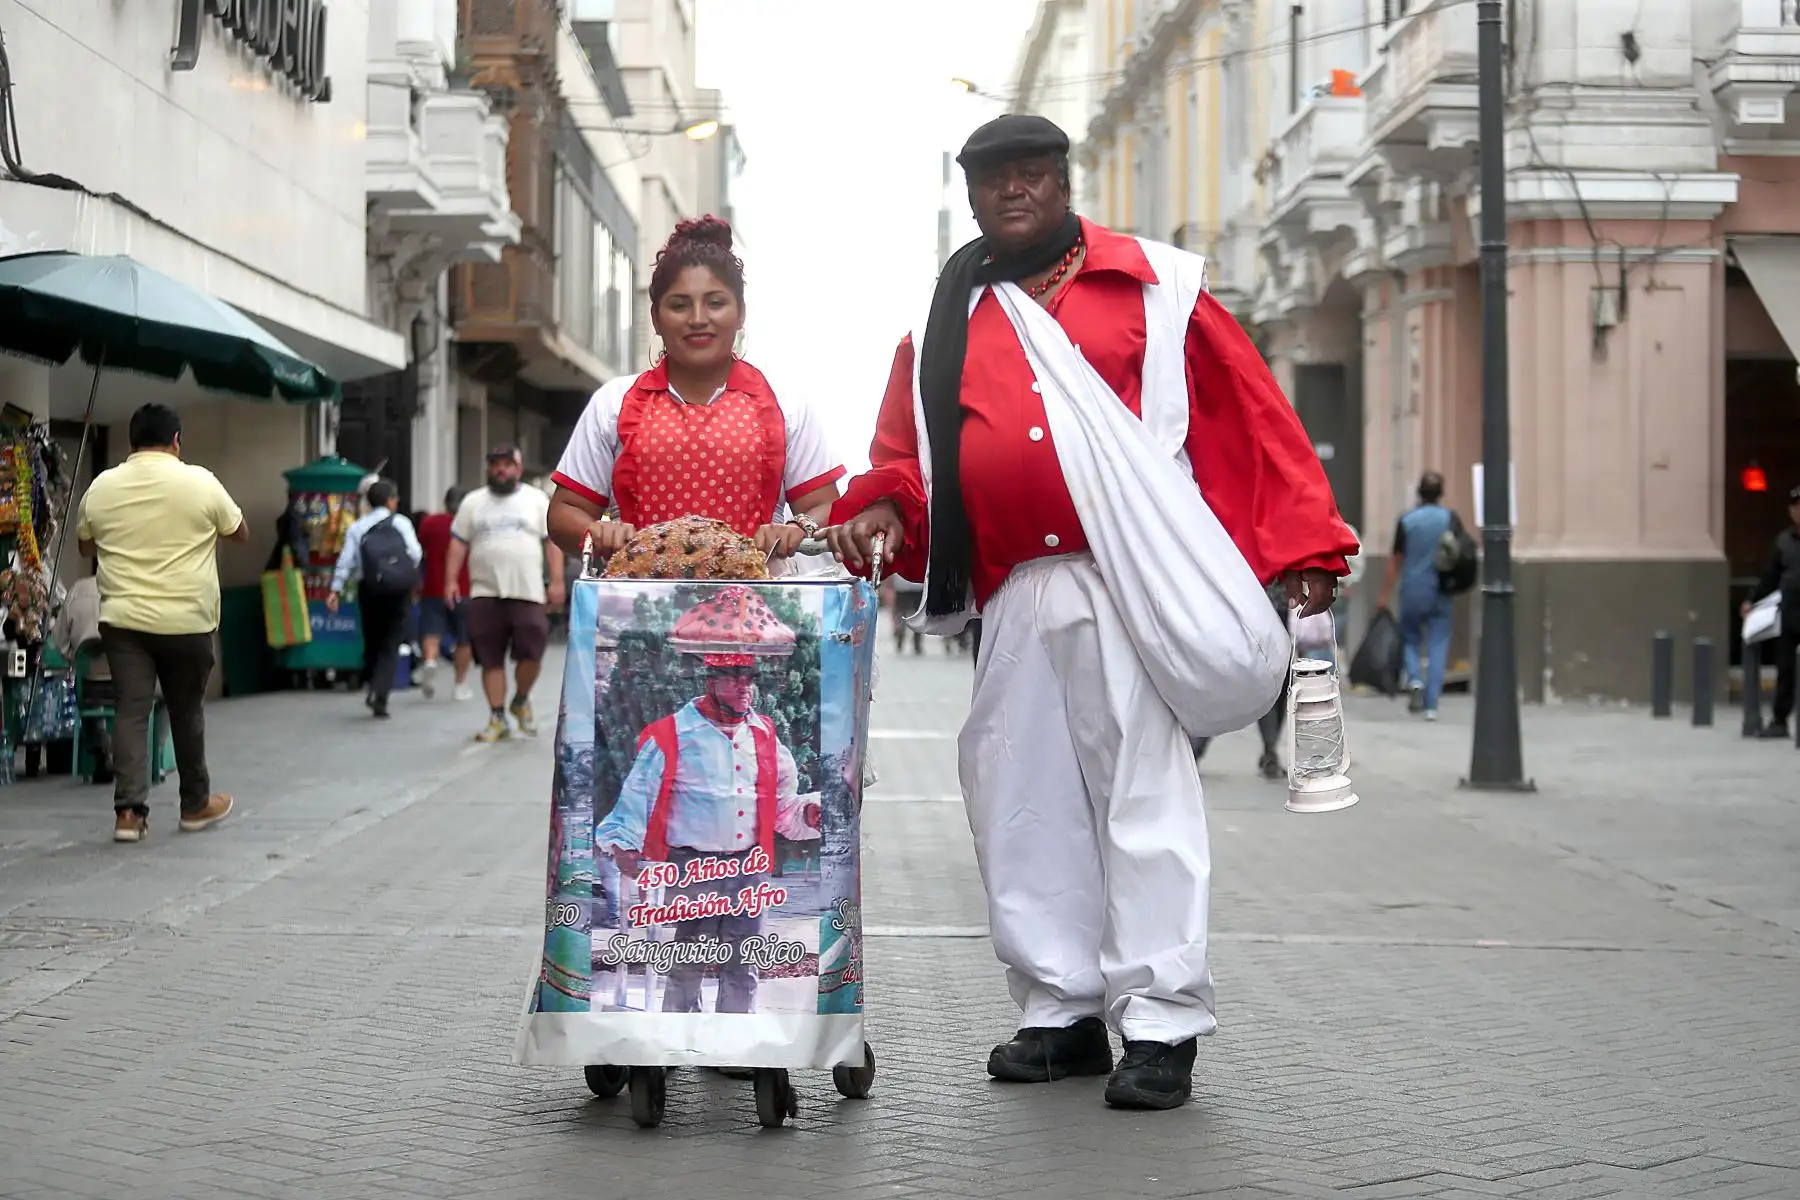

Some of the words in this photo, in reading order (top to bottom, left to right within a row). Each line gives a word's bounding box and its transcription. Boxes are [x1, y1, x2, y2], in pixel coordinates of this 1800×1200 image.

[637, 864, 679, 890] 450
[679, 856, 739, 887] Años
[741, 846, 770, 874] de
[629, 893, 731, 928] Tradición
[733, 883, 787, 918] Afro
[602, 934, 732, 973] Sanguito
[740, 932, 805, 969] Rico
